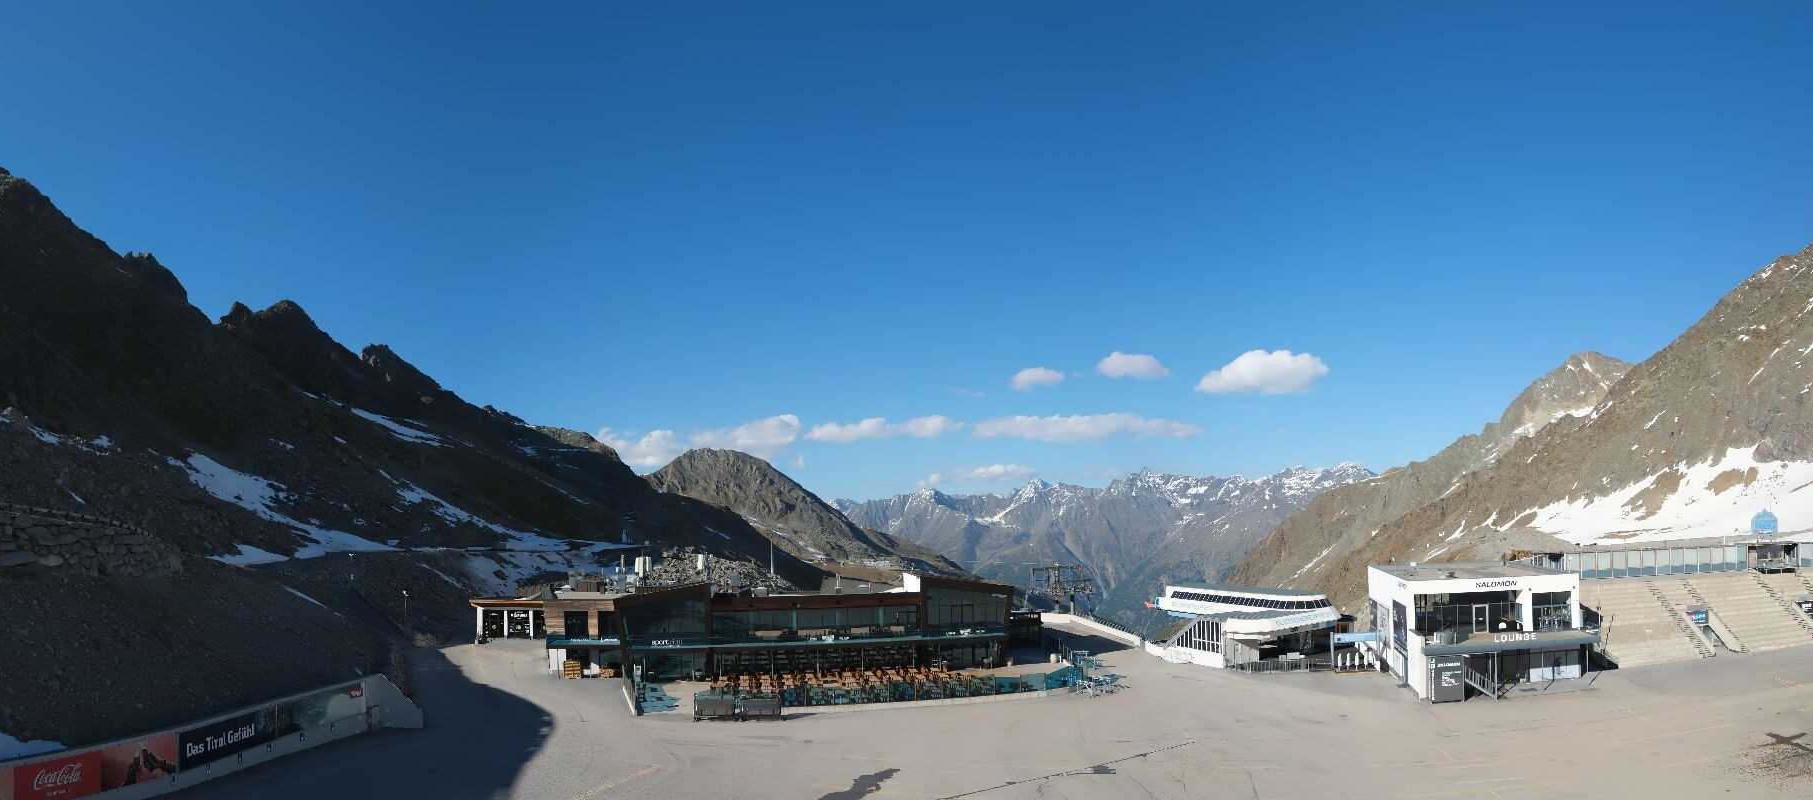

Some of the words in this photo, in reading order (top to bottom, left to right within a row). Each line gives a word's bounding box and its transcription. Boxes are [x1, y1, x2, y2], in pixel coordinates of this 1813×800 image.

[1494, 633, 1537, 643] LOUNGE
[186, 742, 205, 758] Das
[206, 732, 227, 751] Tirol
[227, 723, 255, 744] Gefühl
